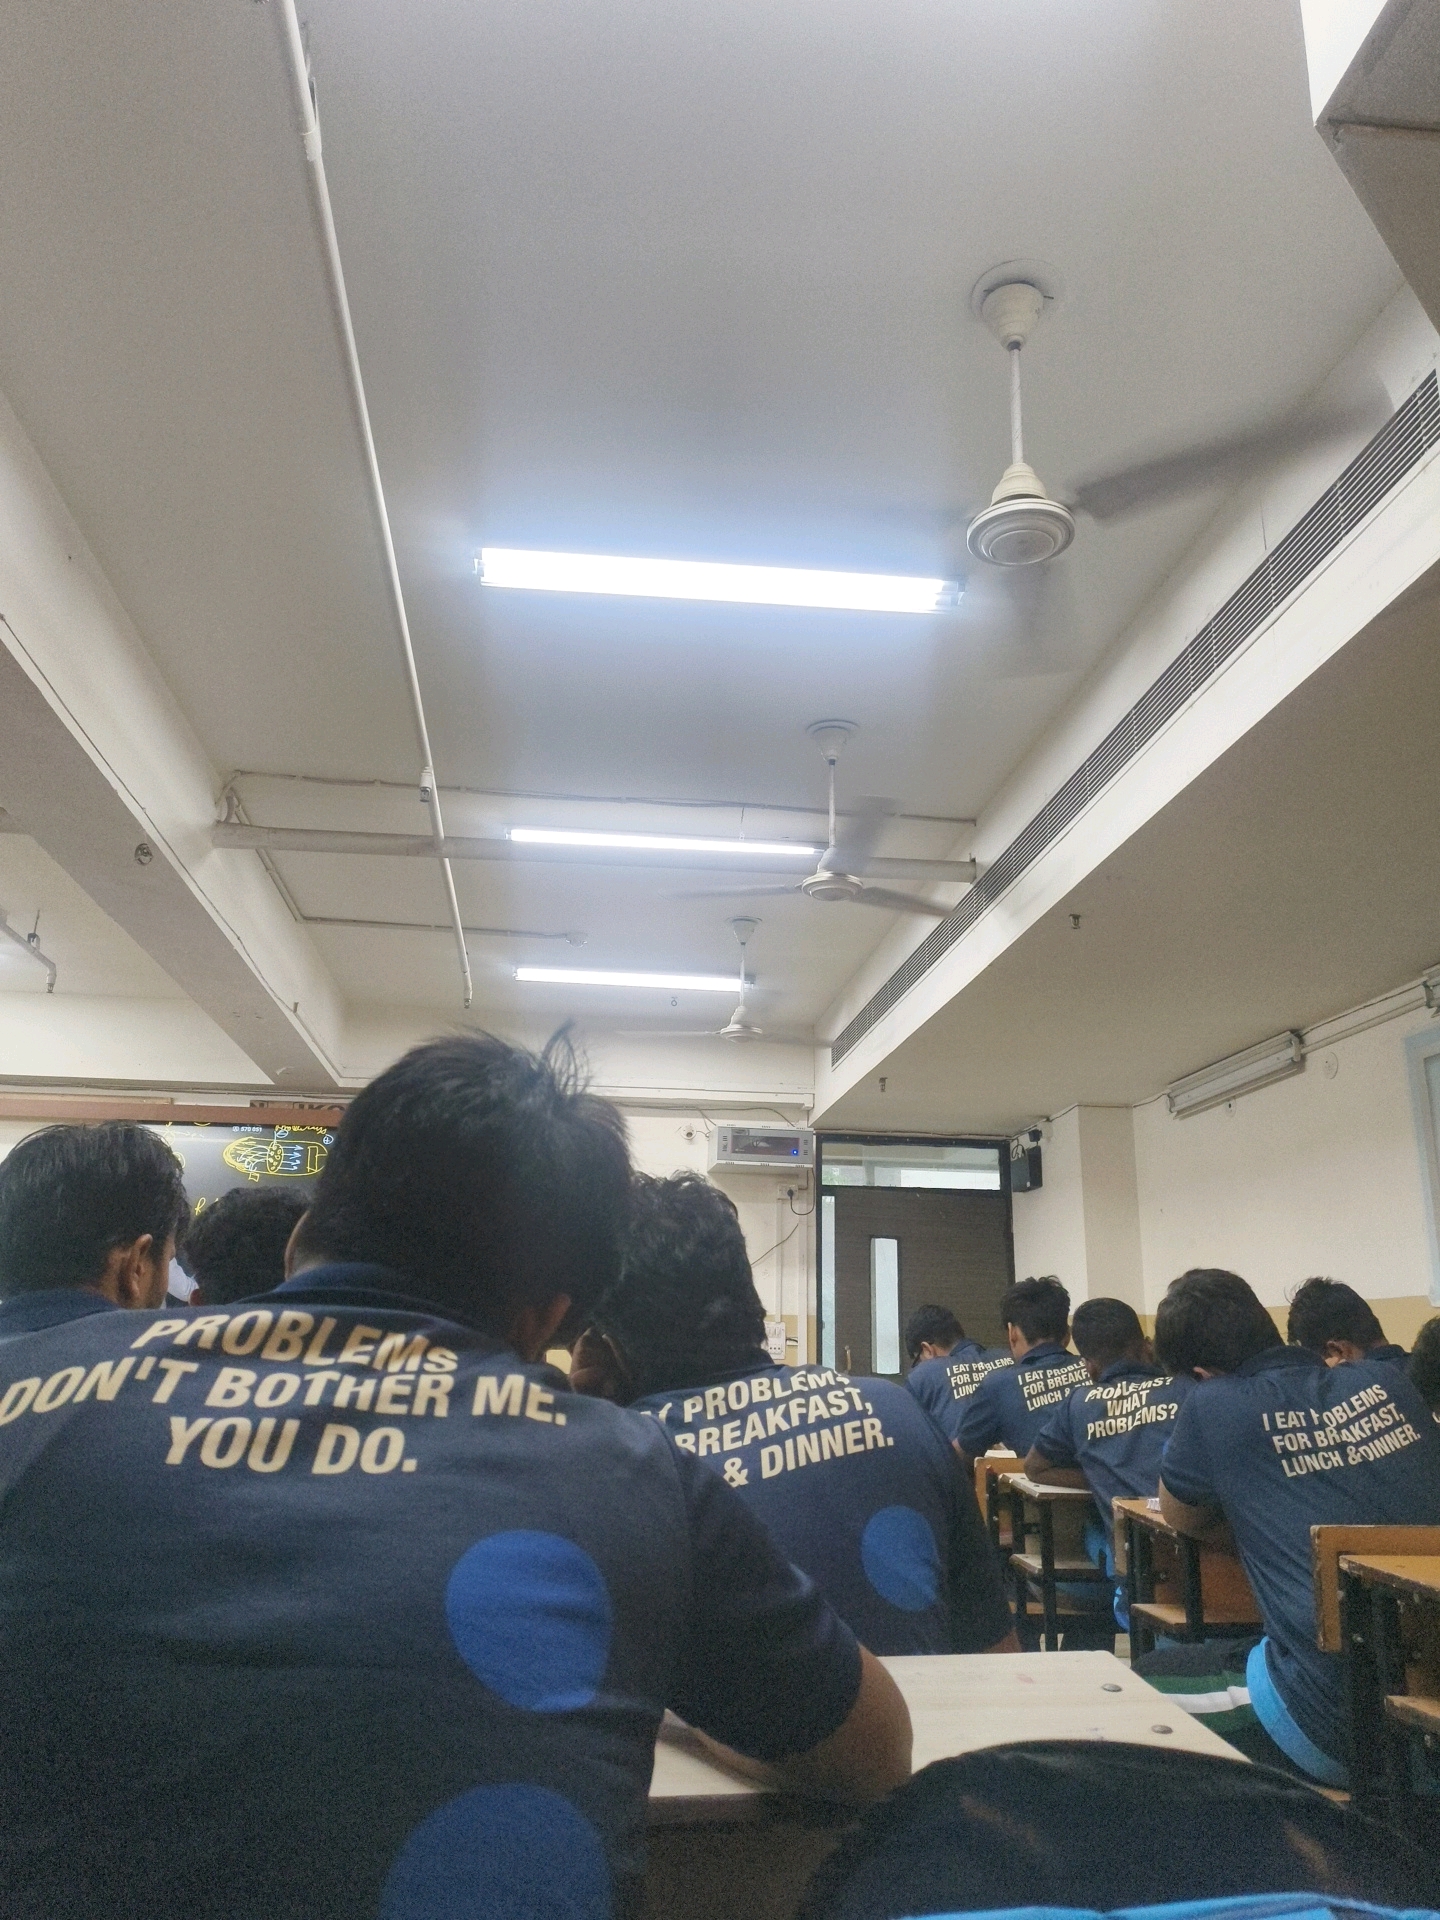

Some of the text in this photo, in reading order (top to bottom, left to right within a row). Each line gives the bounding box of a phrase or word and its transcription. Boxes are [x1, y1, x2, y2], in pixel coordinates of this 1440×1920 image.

[131, 1310, 458, 1374] PROBLEMS
[946, 1357, 1015, 1377] I EAT PRBLEMS
[950, 1373, 971, 1387] FOR
[1017, 1360, 1086, 1386] I EAT PROBLE
[1023, 1381, 1045, 1398] FOR
[1047, 1368, 1090, 1390] BREAKF
[0, 1356, 568, 1426] DON'T BOTHER ME.
[1026, 1390, 1063, 1412] LUNCH
[1107, 1389, 1150, 1417] WHAT
[675, 1387, 873, 1457] BREAKFAST,
[1087, 1403, 1179, 1441] PROBLEMS?
[1262, 1413, 1270, 1431] I
[1274, 1411, 1307, 1429] EAT
[1272, 1402, 1406, 1454] FOR BRAKFAST,
[165, 1416, 418, 1475] YOU DO.
[723, 1417, 894, 1488] & DINNER.
[1281, 1423, 1422, 1478] LUNCH & DINNER.
